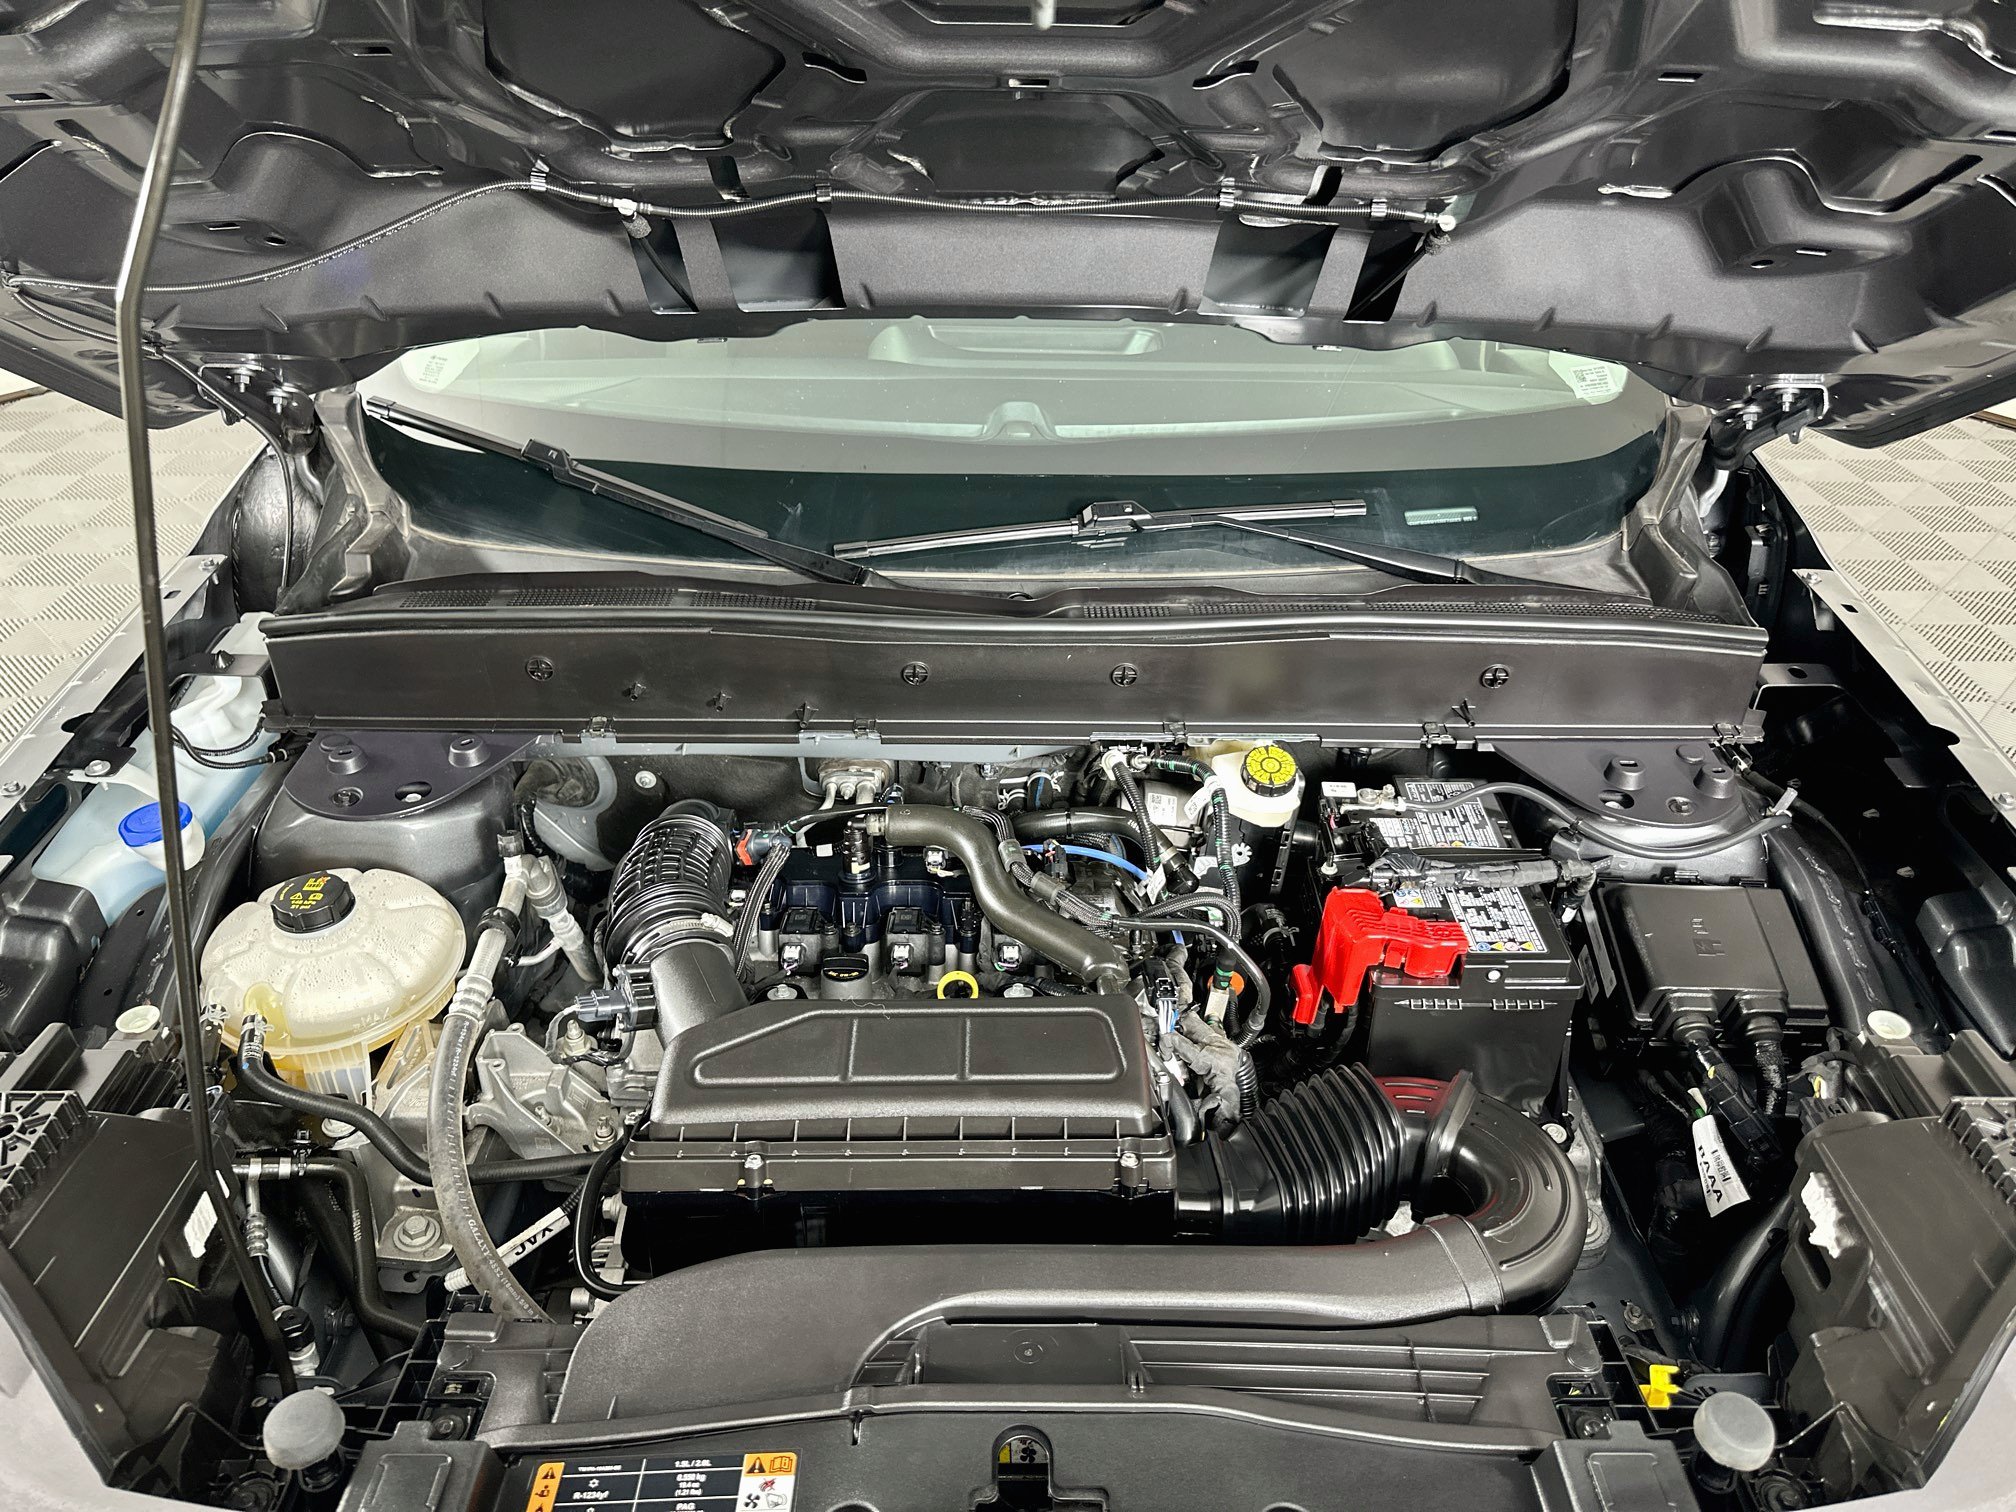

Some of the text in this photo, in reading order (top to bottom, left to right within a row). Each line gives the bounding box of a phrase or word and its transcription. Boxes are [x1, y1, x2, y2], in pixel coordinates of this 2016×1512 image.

[468, 1219, 492, 1257] GALAXY
[572, 1490, 610, 1501] R-1234yf
[675, 1502, 696, 1511] PAG
